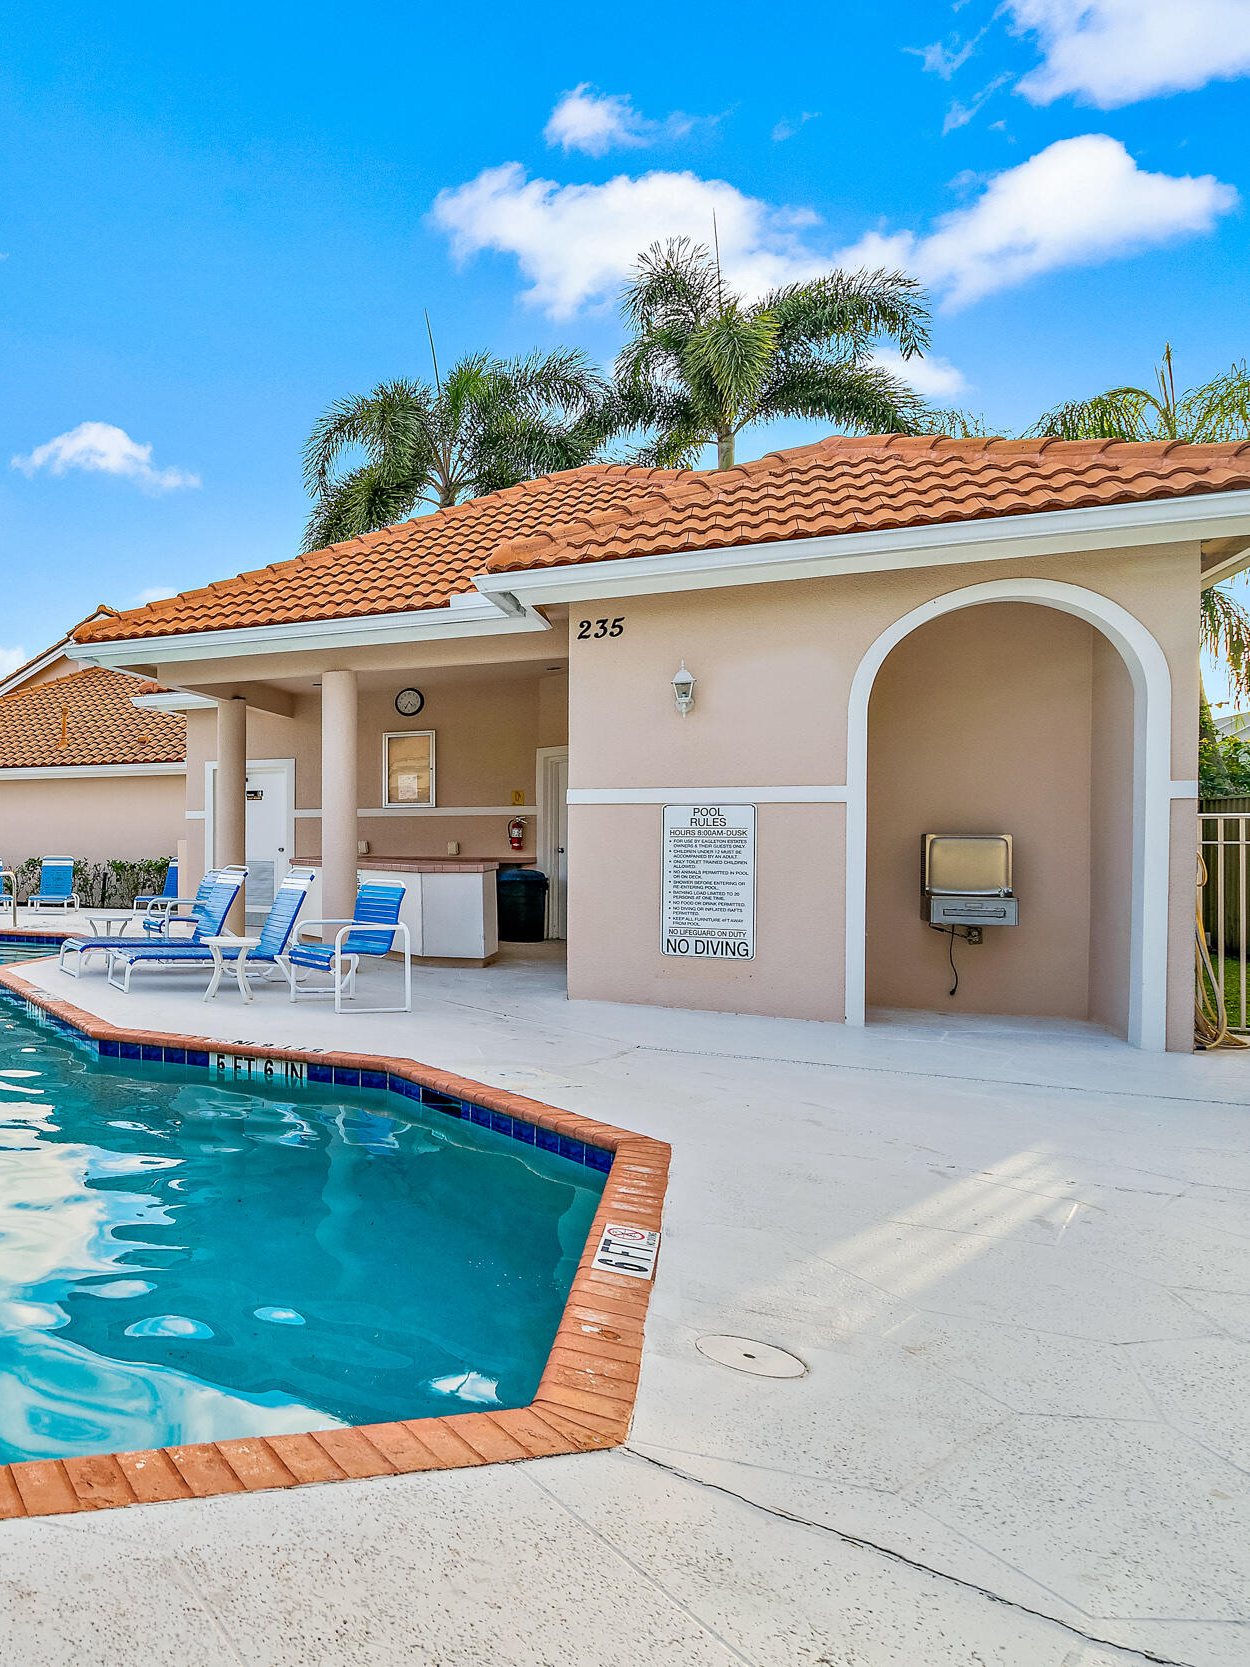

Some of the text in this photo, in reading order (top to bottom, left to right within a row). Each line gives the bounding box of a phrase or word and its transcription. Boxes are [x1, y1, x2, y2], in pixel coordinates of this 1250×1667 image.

[577, 616, 626, 640] 235
[690, 818, 726, 826] RULES
[693, 808, 724, 816] POOL
[667, 939, 749, 957] NO DIVING
[216, 1054, 303, 1079] 5 FT 6 IN
[598, 1238, 653, 1272] 6 FT
